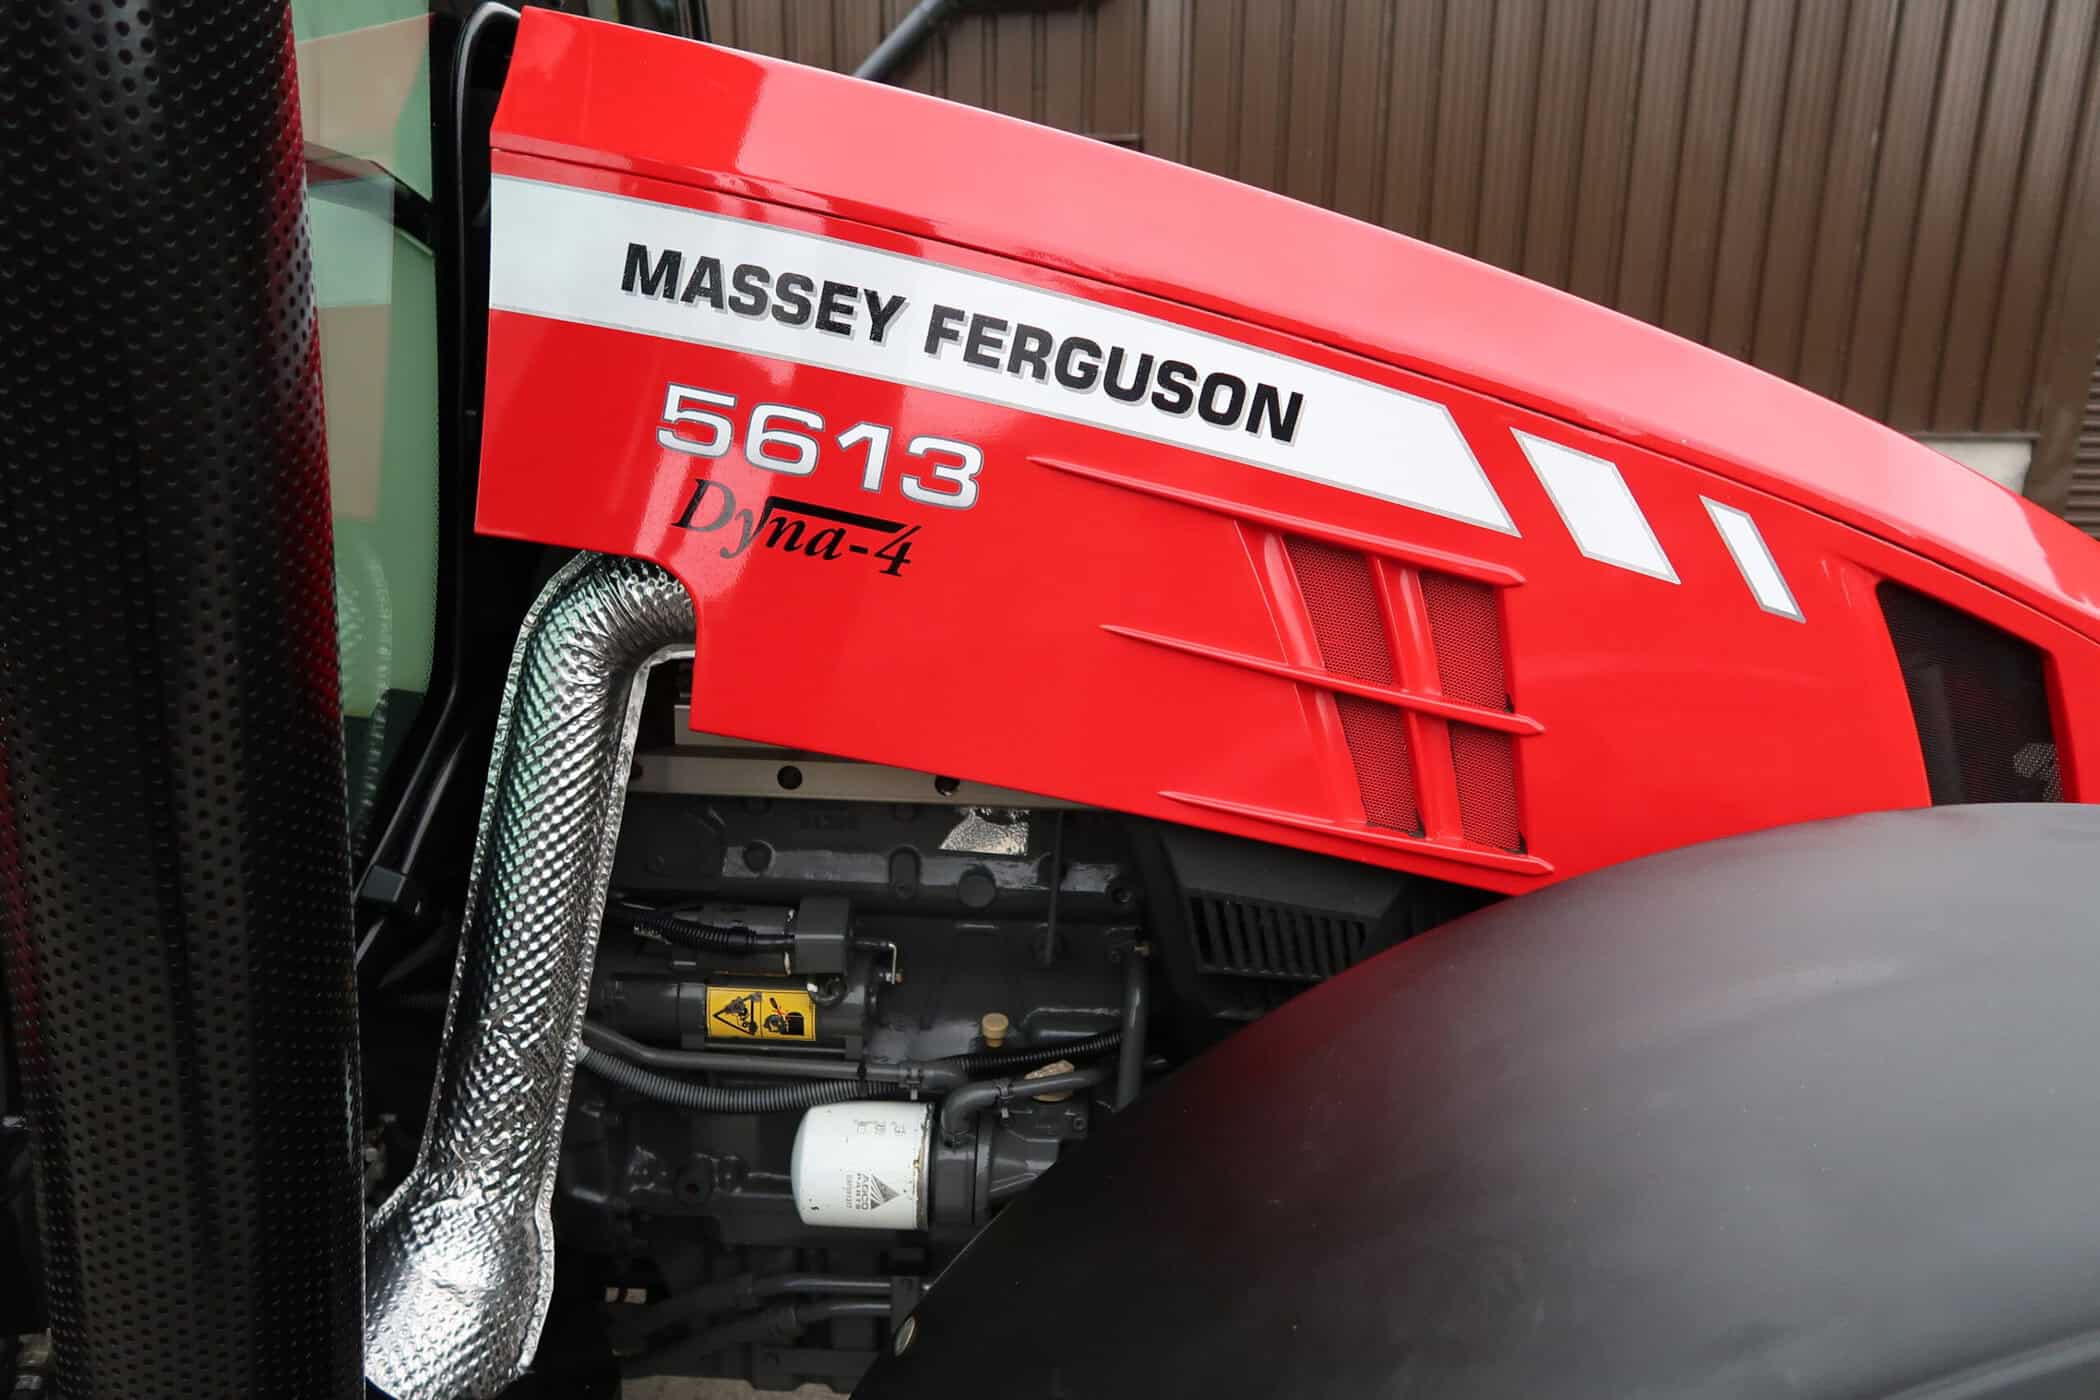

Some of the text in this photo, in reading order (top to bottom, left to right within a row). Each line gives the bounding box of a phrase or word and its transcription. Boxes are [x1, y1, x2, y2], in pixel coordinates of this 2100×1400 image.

[621, 243, 1306, 446] MASSEY FERGUSON
[655, 382, 985, 510] 5613
[671, 480, 922, 577] Dyna-4
